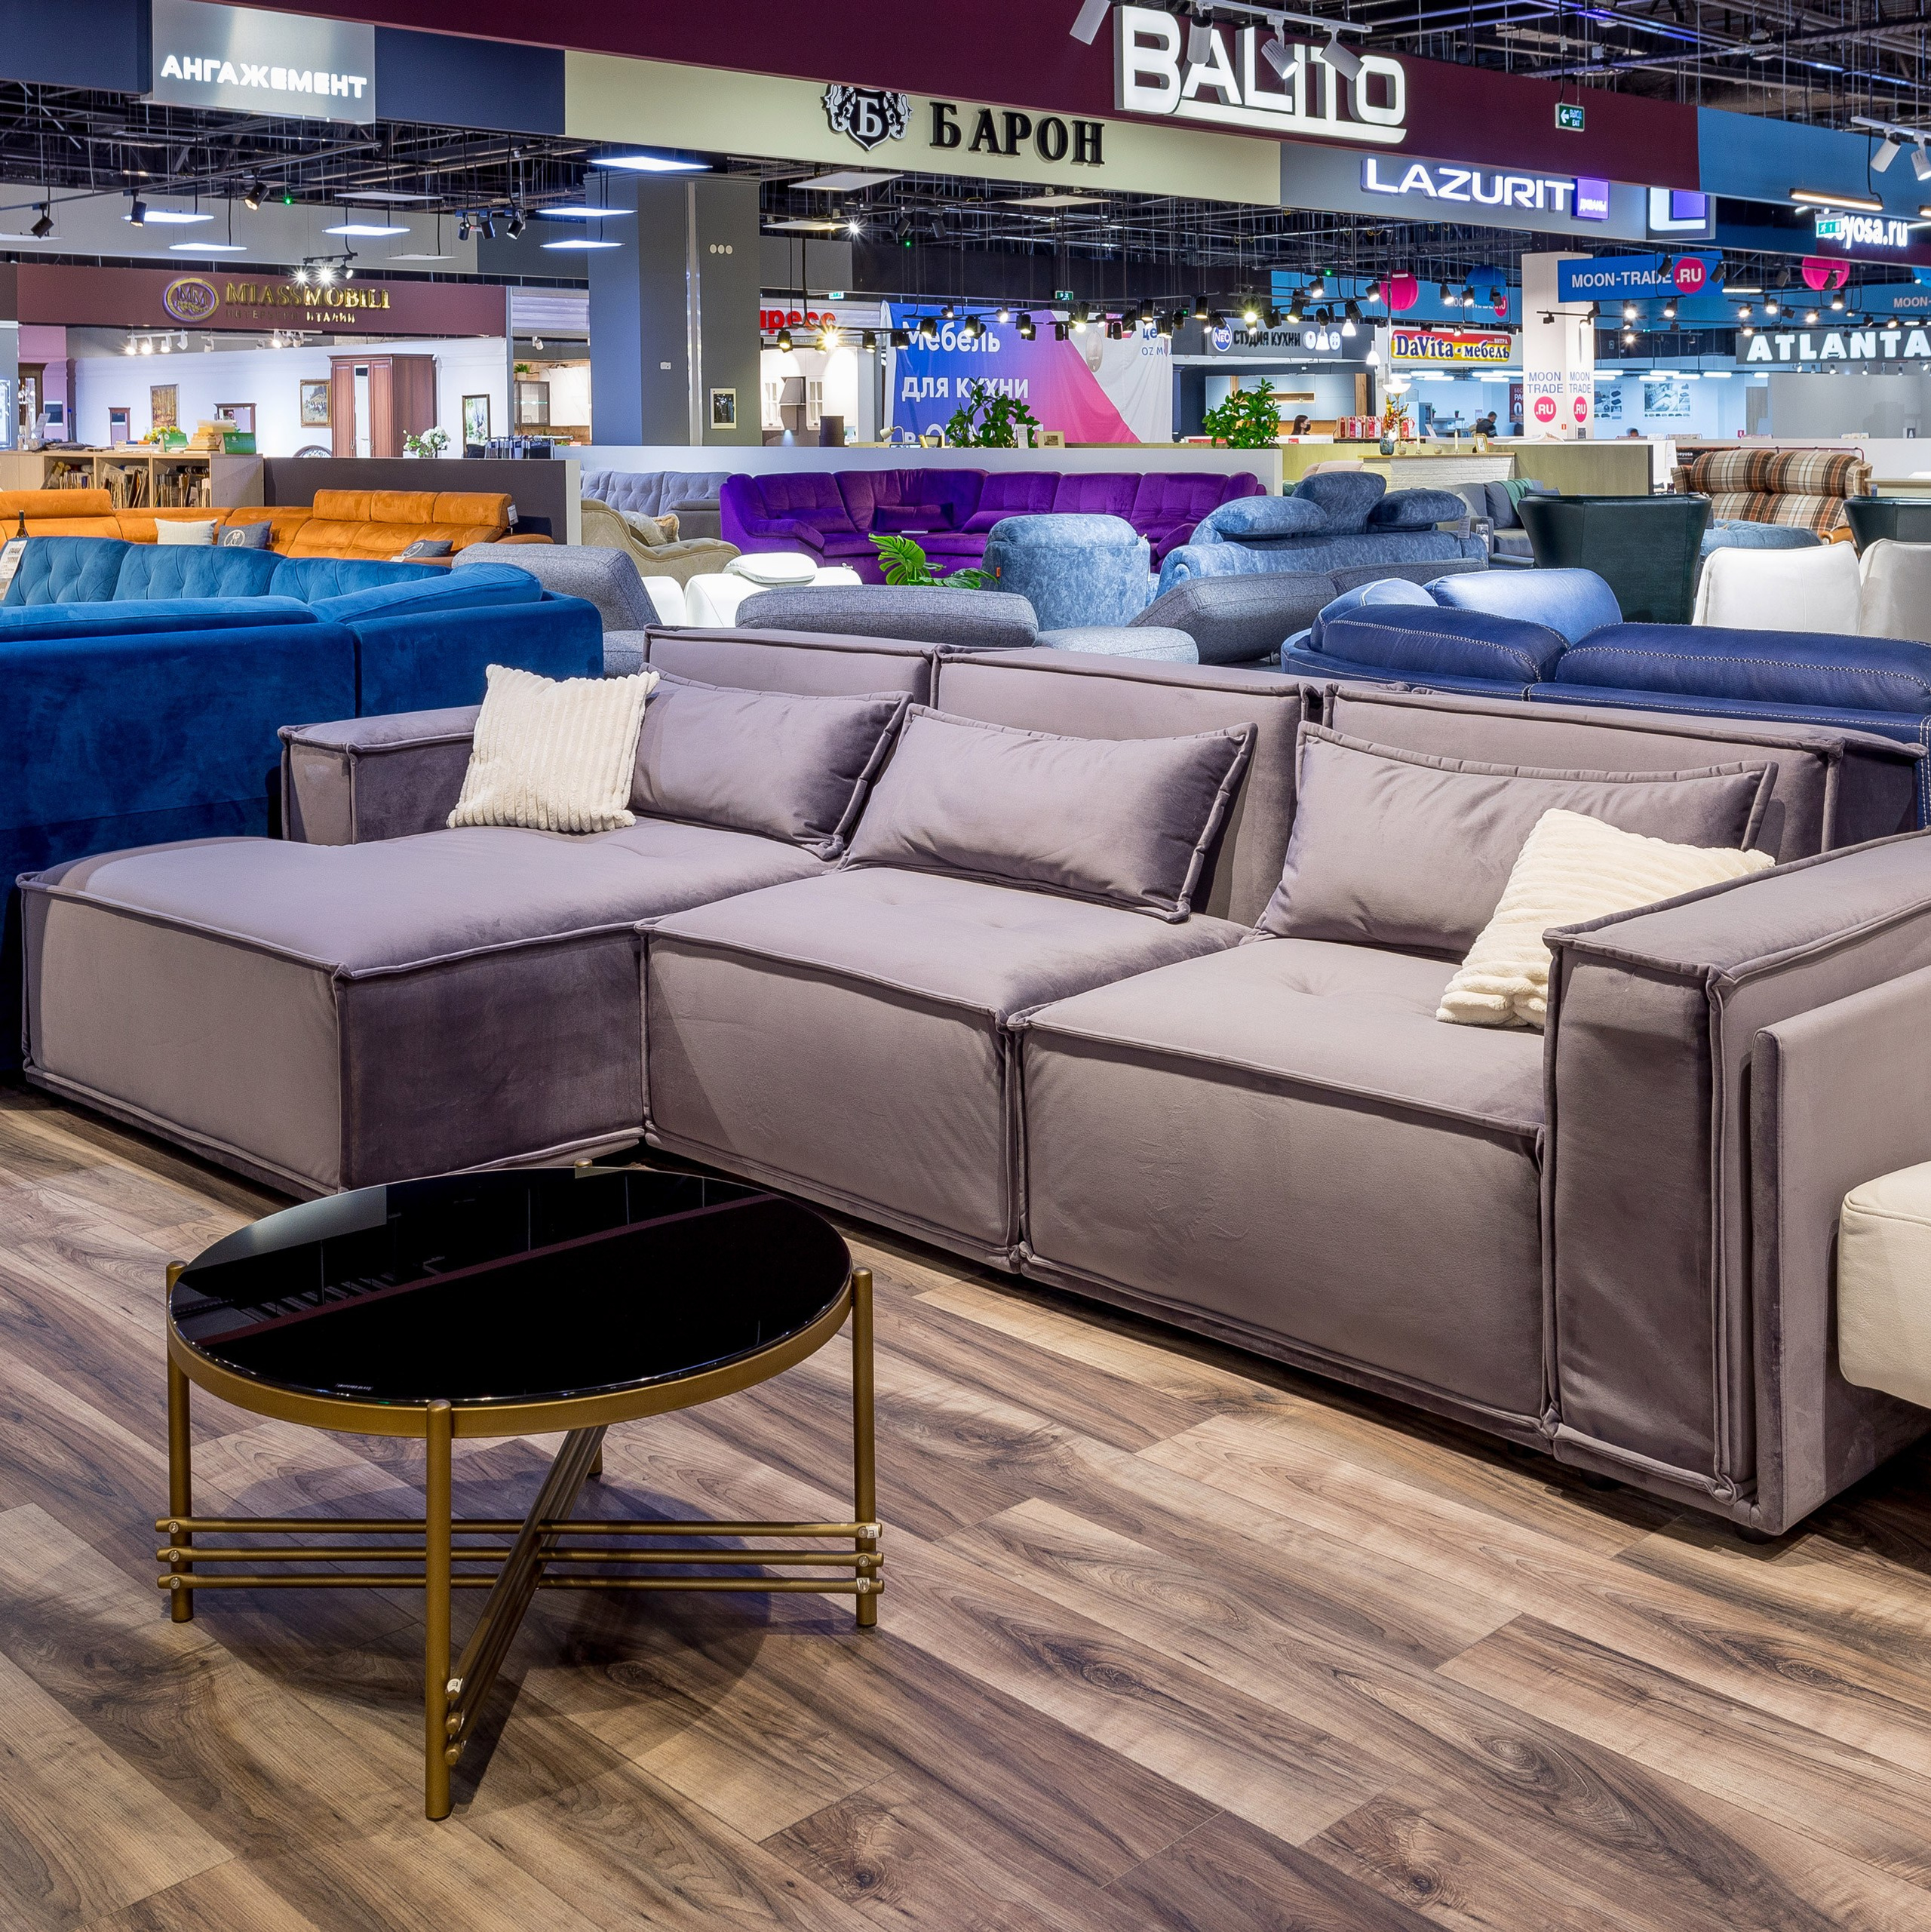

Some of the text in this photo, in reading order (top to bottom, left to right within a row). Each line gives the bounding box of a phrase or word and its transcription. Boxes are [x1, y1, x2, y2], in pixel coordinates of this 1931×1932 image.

[161, 55, 367, 99] АНГАЖЕМЕНТ
[1116, 5, 1407, 143] BALITO
[856, 97, 883, 137] Б
[929, 101, 1106, 166] БАРОН
[1362, 158, 1575, 212] LAZURIT
[1824, 216, 1908, 250] yosa.ru
[1676, 268, 1702, 284] .RU
[306, 311, 356, 324] ИТАЛИИ
[1233, 330, 1301, 348] СТУДИЯ КУХНИ
[1395, 335, 1509, 359] DaVita мебель
[1746, 330, 1931, 361] ATLANTA
[1528, 371, 1561, 382] MOON
[1570, 371, 1590, 382] MOON
[901, 376, 949, 402] для
[1527, 383, 1564, 394] TRADE
[1569, 383, 1592, 394] TRADE
[1536, 404, 1554, 415] .RU
[1574, 404, 1586, 415] .RU
